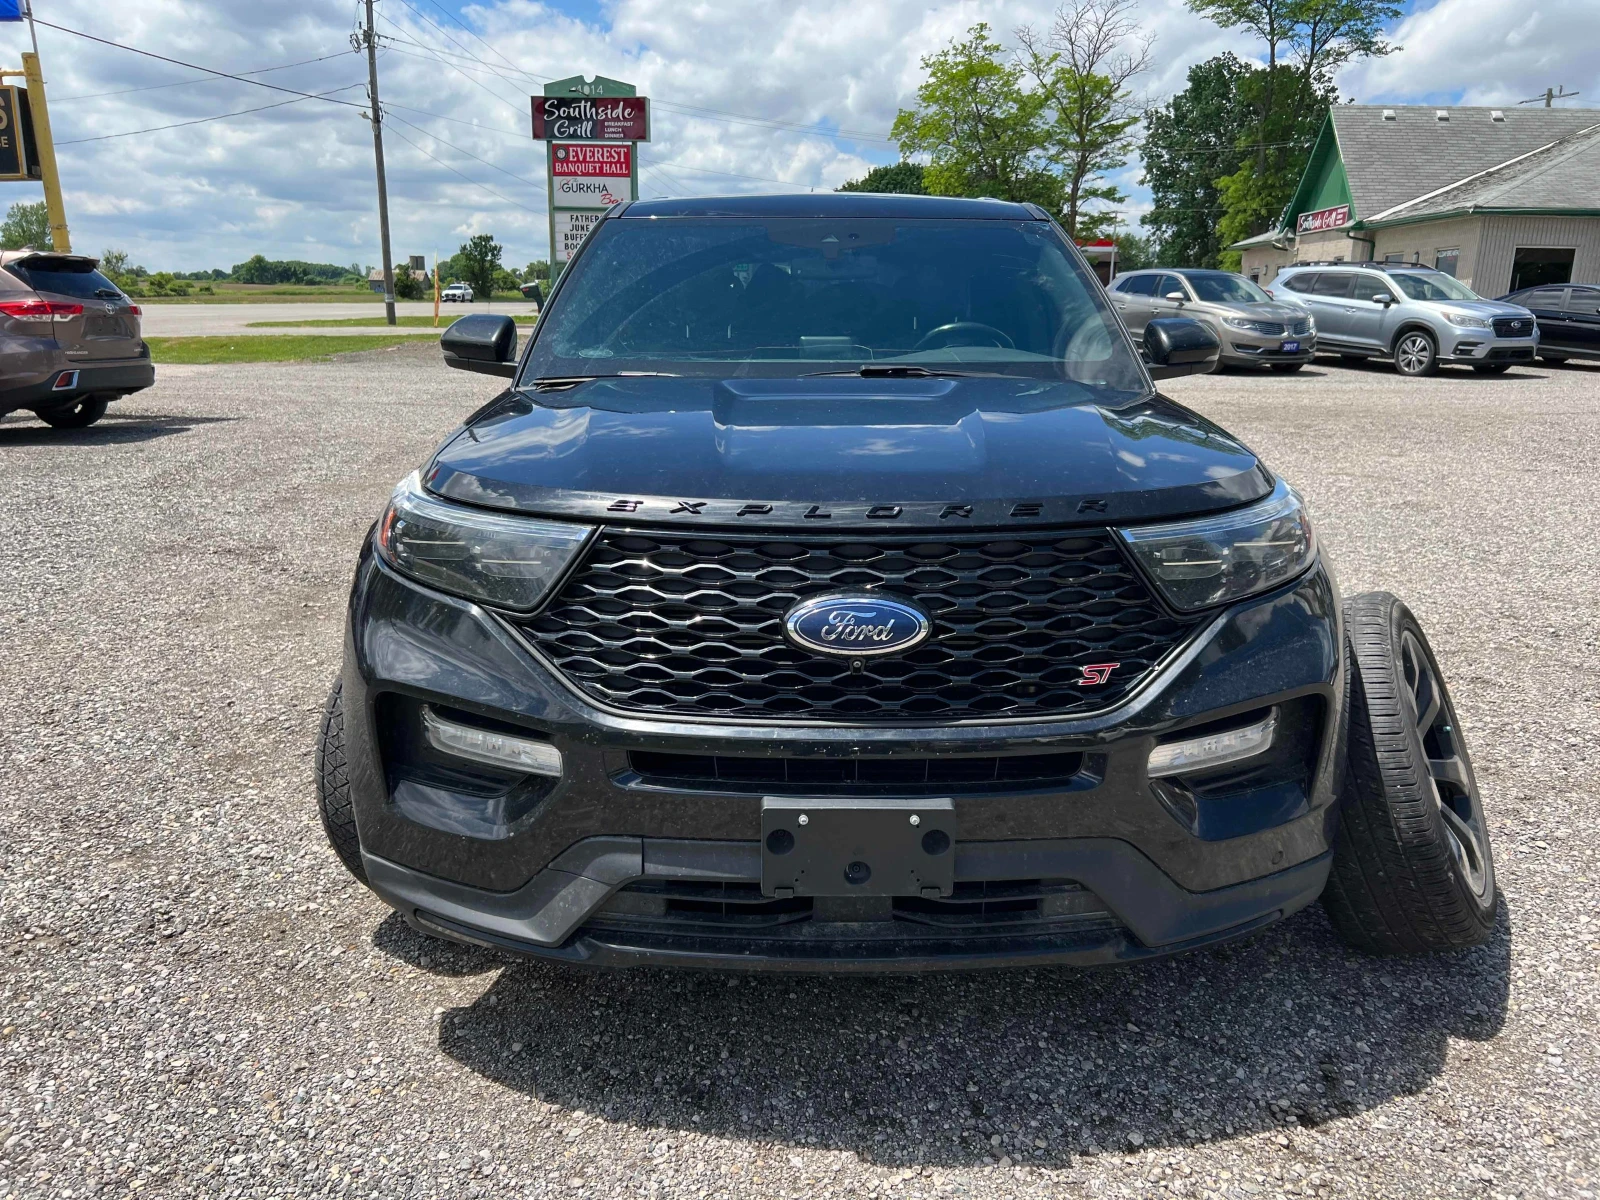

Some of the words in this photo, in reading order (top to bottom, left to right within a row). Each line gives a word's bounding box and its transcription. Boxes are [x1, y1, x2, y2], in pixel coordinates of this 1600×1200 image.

[543, 99, 635, 121] Southside
[554, 119, 593, 138] Grill
[569, 147, 627, 162] EVEREST
[555, 162, 601, 175] BANQUET
[603, 163, 629, 174] HALL
[561, 182, 609, 194] GURKHA
[600, 193, 624, 205] Bo
[569, 223, 590, 232] JUNE
[1283, 342, 1298, 351] 2017
[606, 499, 1108, 519] EXPLORER
[820, 610, 895, 641] Ford
[1077, 662, 1120, 686] ST
